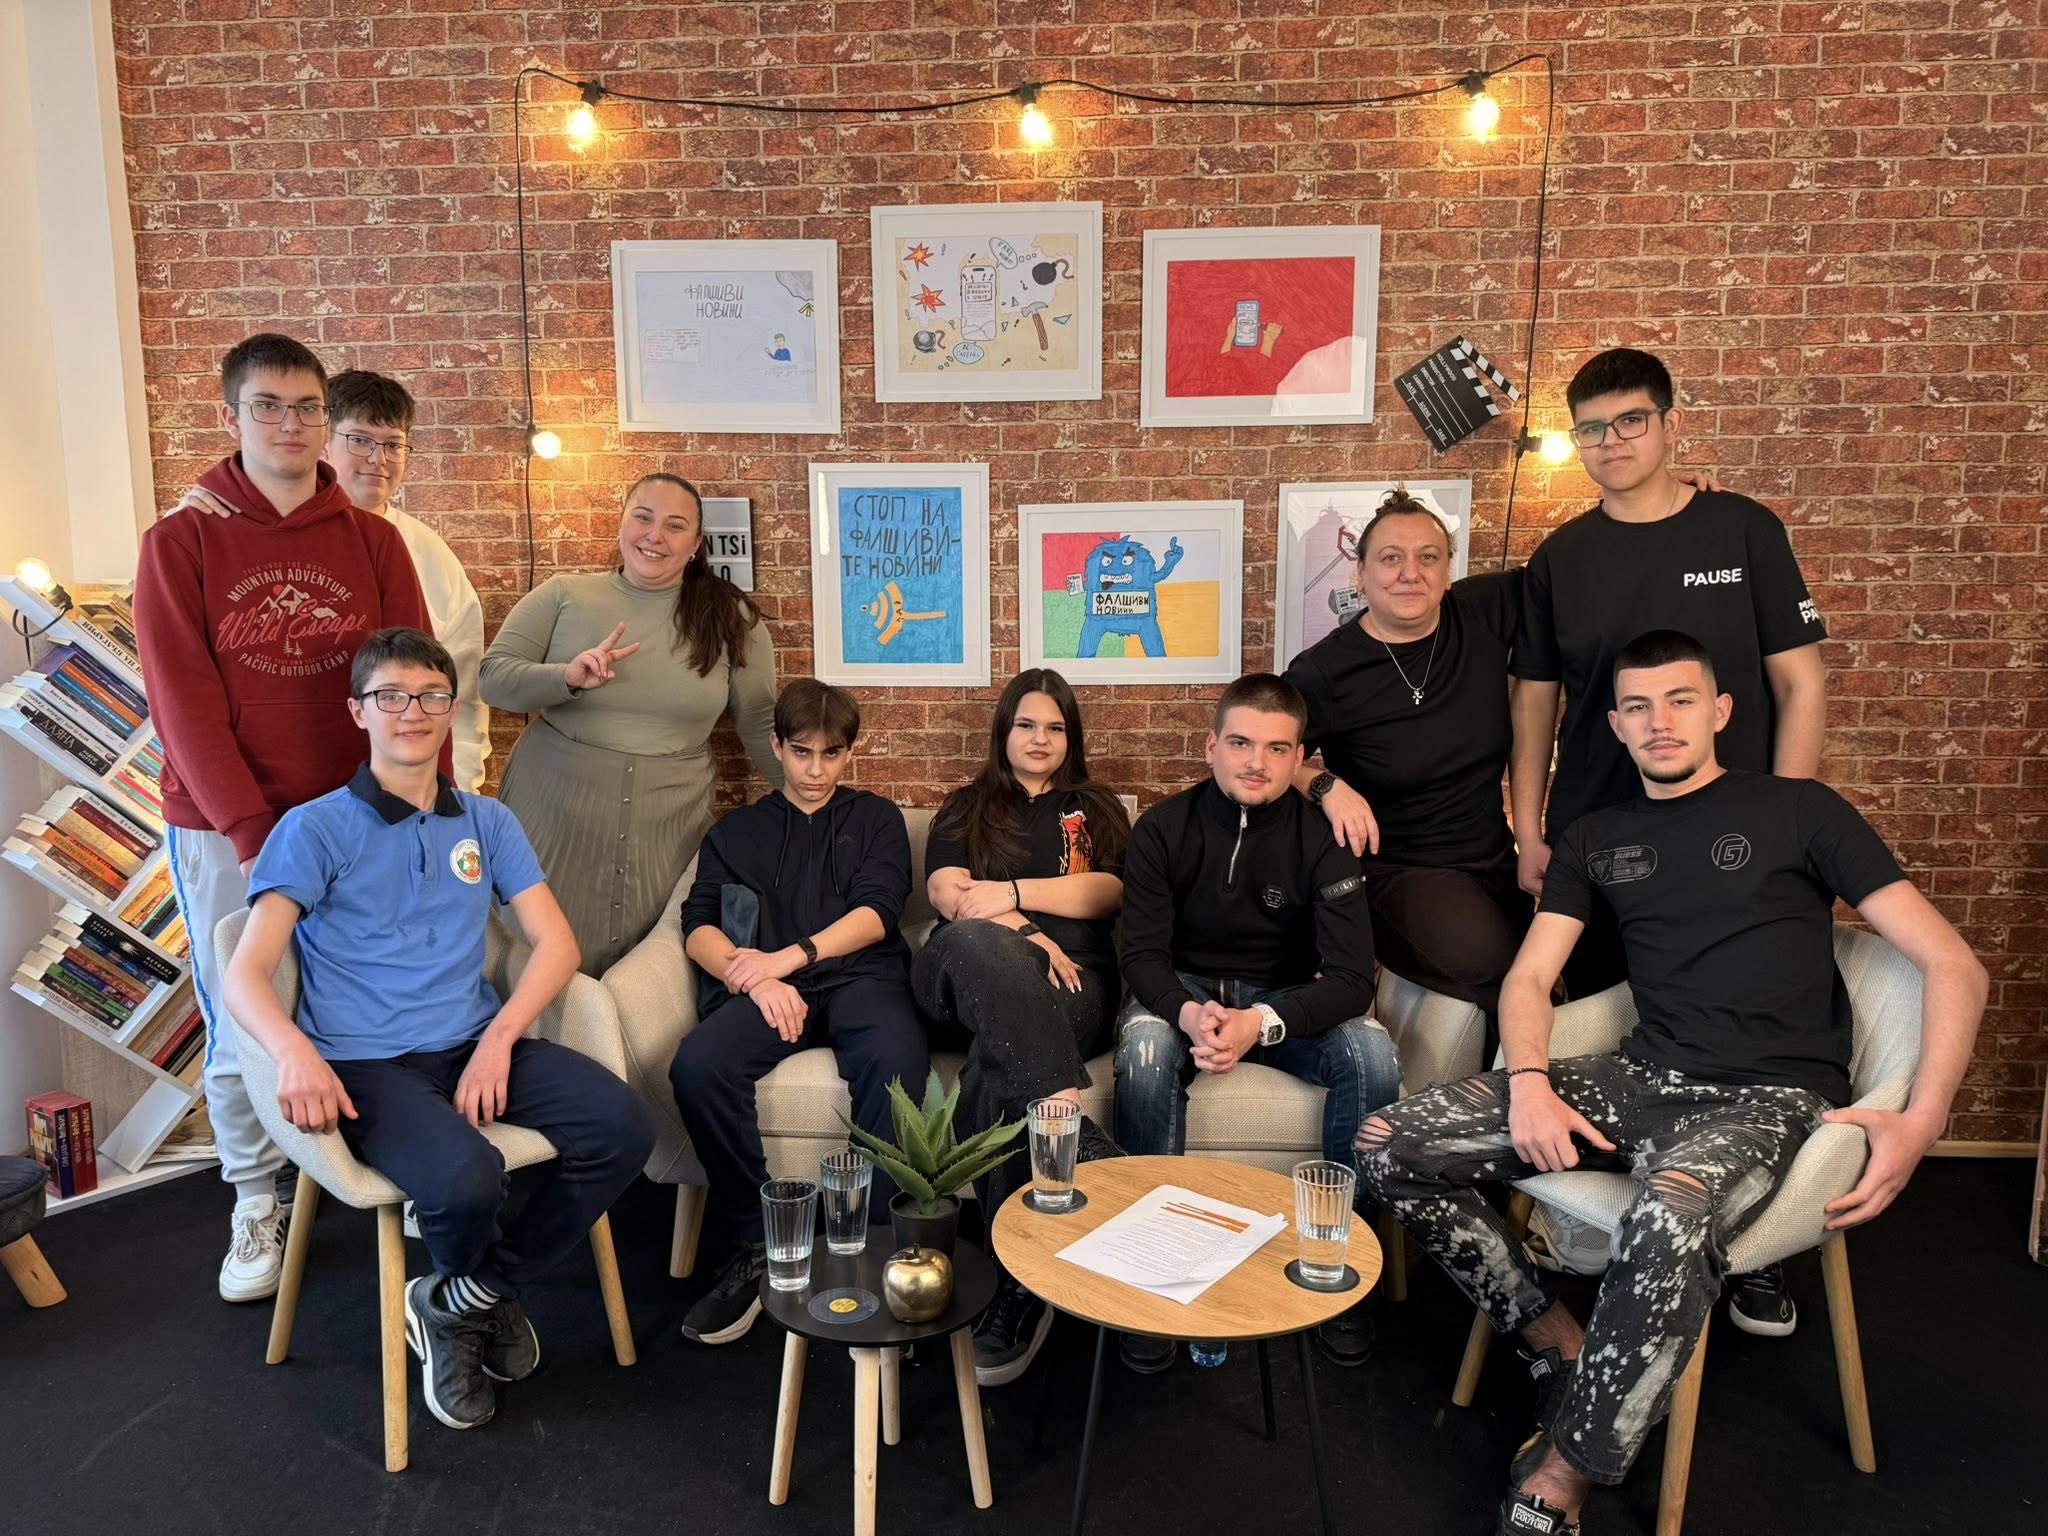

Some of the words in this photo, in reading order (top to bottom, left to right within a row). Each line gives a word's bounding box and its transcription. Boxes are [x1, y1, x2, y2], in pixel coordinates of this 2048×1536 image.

[696, 302, 743, 319] НОВИНИ
[1420, 367, 1435, 386] DIRECTOR
[1428, 359, 1446, 384] PRODUCTION
[1436, 353, 1457, 381] HOLLYWOOD
[1412, 374, 1425, 390] CAMERA
[1406, 382, 1417, 395] DATE
[1419, 401, 1432, 418] SCENE
[1437, 428, 1447, 442] TAKE
[853, 495, 906, 522] СТОП
[921, 498, 945, 527] НА
[841, 556, 862, 577] ТЕ
[868, 553, 943, 580] НОВИНИ
[1683, 567, 1743, 587] PAUSE
[227, 569, 283, 603] MOUNTAIN
[287, 568, 353, 602] ADVENTURE
[1095, 593, 1149, 606] ФАЛШИВИ
[1096, 605, 1134, 616] НОВИНИ
[216, 606, 289, 653] Wild
[288, 600, 368, 645] Escape
[238, 653, 277, 675] PACIFIC
[280, 662, 322, 677] OUTDOOR
[324, 650, 349, 671] CAMP
[40, 719, 75, 749] ДАЯНА
[1515, 1512, 1548, 1533] COUTURE
